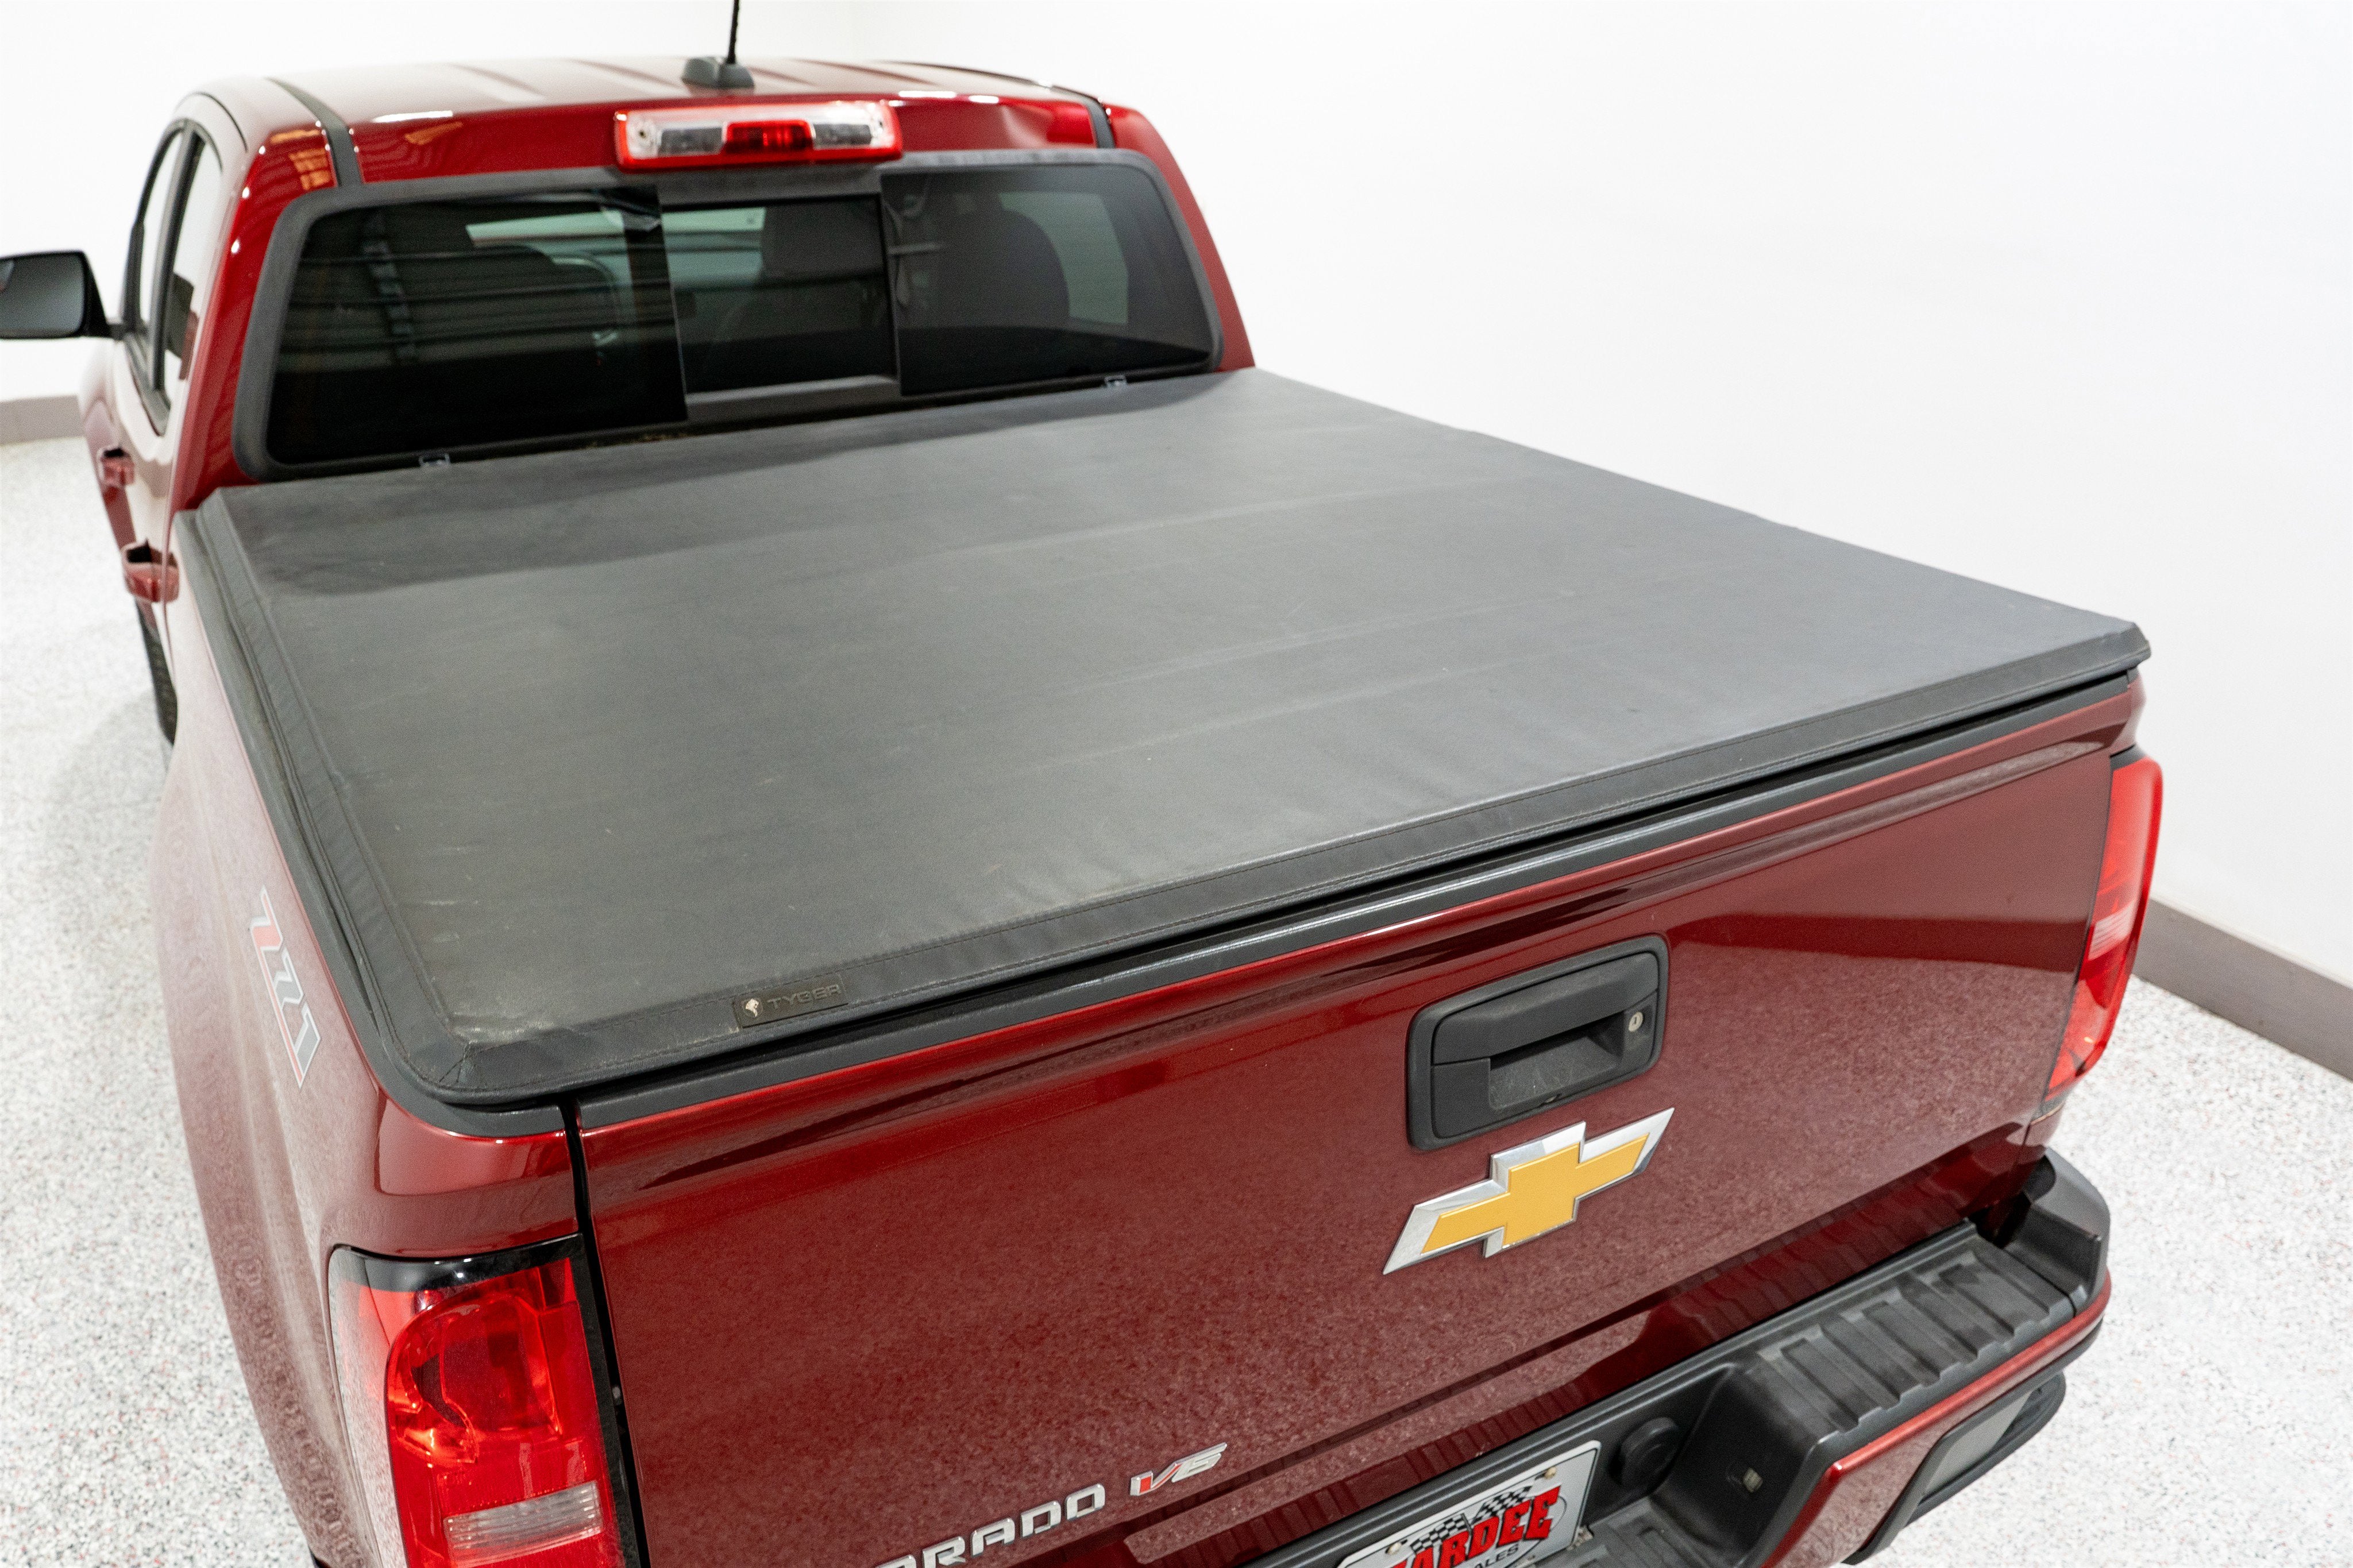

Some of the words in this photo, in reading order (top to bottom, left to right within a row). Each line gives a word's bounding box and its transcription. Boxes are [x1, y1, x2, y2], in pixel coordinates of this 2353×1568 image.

[767, 984, 842, 1009] TYGER
[874, 1483, 1106, 1568] RADO
[1130, 1442, 1228, 1496] V6
[1392, 1485, 1561, 1568] ARDEE
